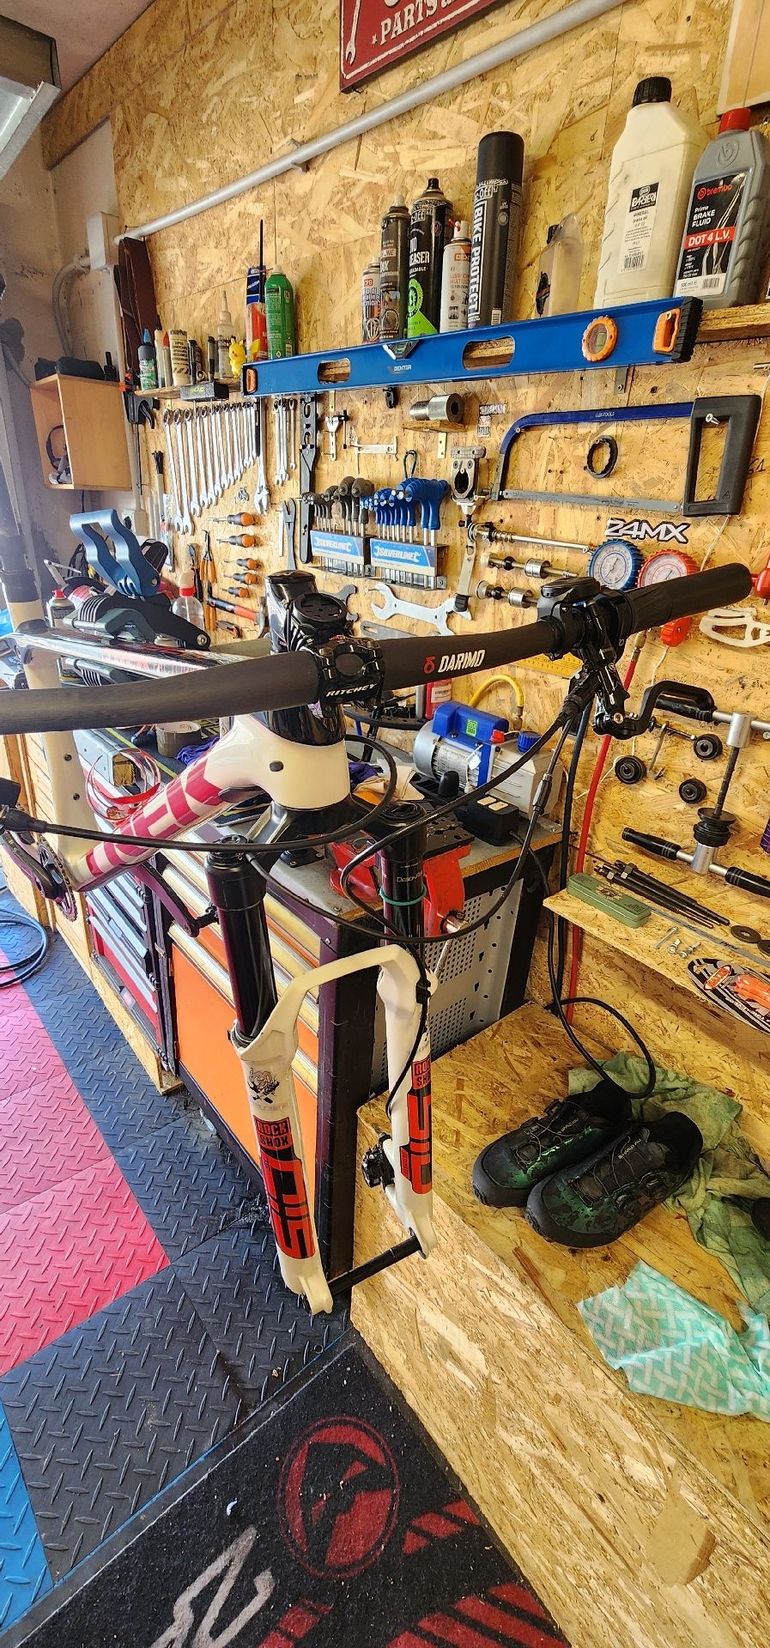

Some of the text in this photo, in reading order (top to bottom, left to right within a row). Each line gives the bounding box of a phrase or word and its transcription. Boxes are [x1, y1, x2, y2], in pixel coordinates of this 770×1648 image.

[706, 184, 733, 196] brembo
[692, 217, 712, 228] FLUID
[693, 209, 716, 221] BRAKE
[688, 234, 708, 247] DOT
[707, 231, 714, 242] 4
[409, 250, 430, 266] EASER
[467, 206, 484, 314] BIKE PROTECT
[605, 517, 691, 544] 24MX
[437, 649, 486, 673] DARIMO
[325, 683, 378, 698] RITCHEY
[256, 1119, 289, 1137] ROCK
[260, 1132, 290, 1148] SHOX
